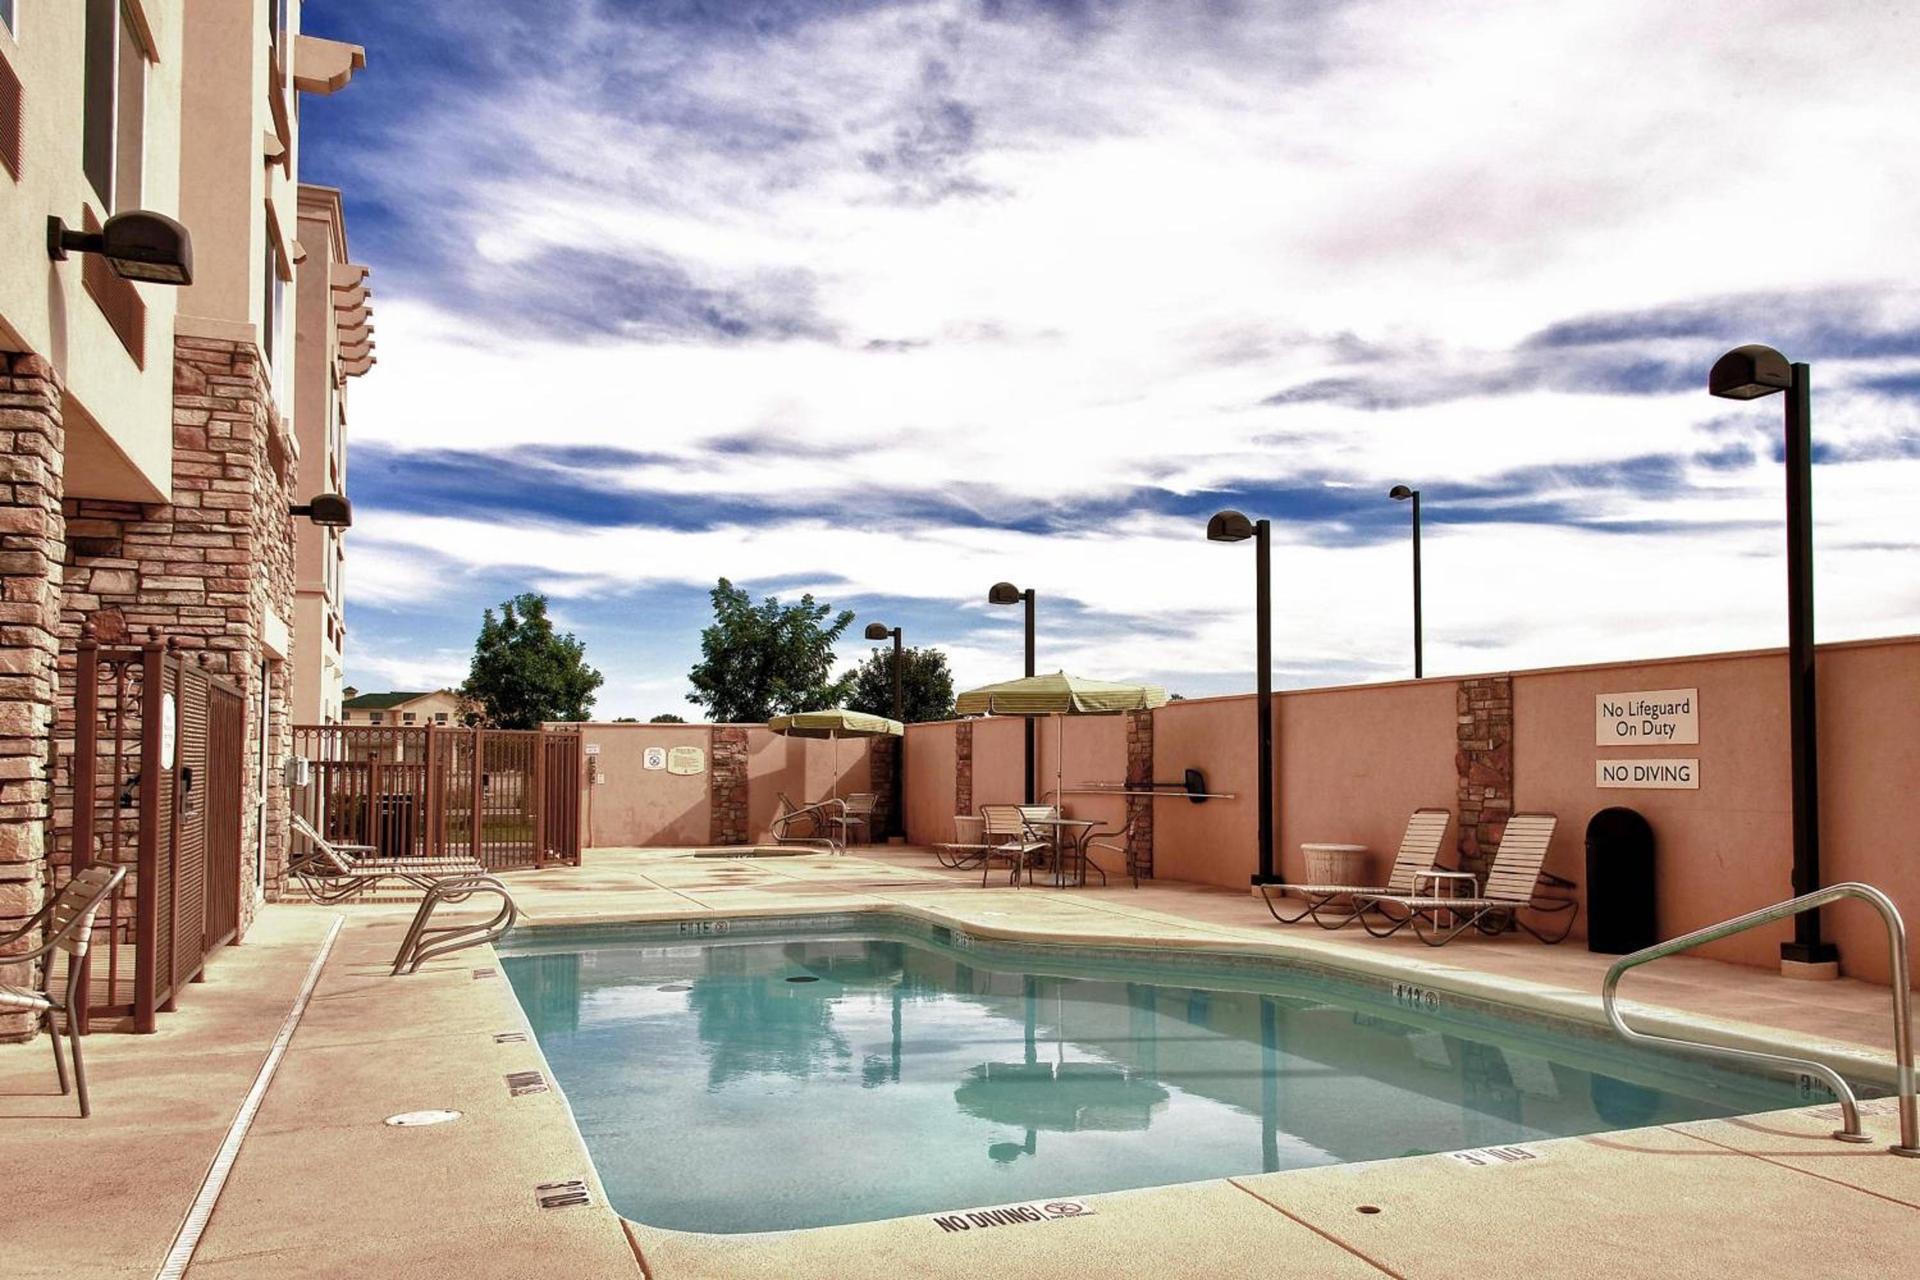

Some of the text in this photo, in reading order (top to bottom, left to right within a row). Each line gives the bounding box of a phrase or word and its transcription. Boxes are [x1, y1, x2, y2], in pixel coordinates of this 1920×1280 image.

[1603, 698, 1690, 720] No Lifeguard
[1616, 720, 1676, 739] On Duty
[1603, 766, 1690, 781] NO DIVING
[933, 1214, 971, 1233] NO
